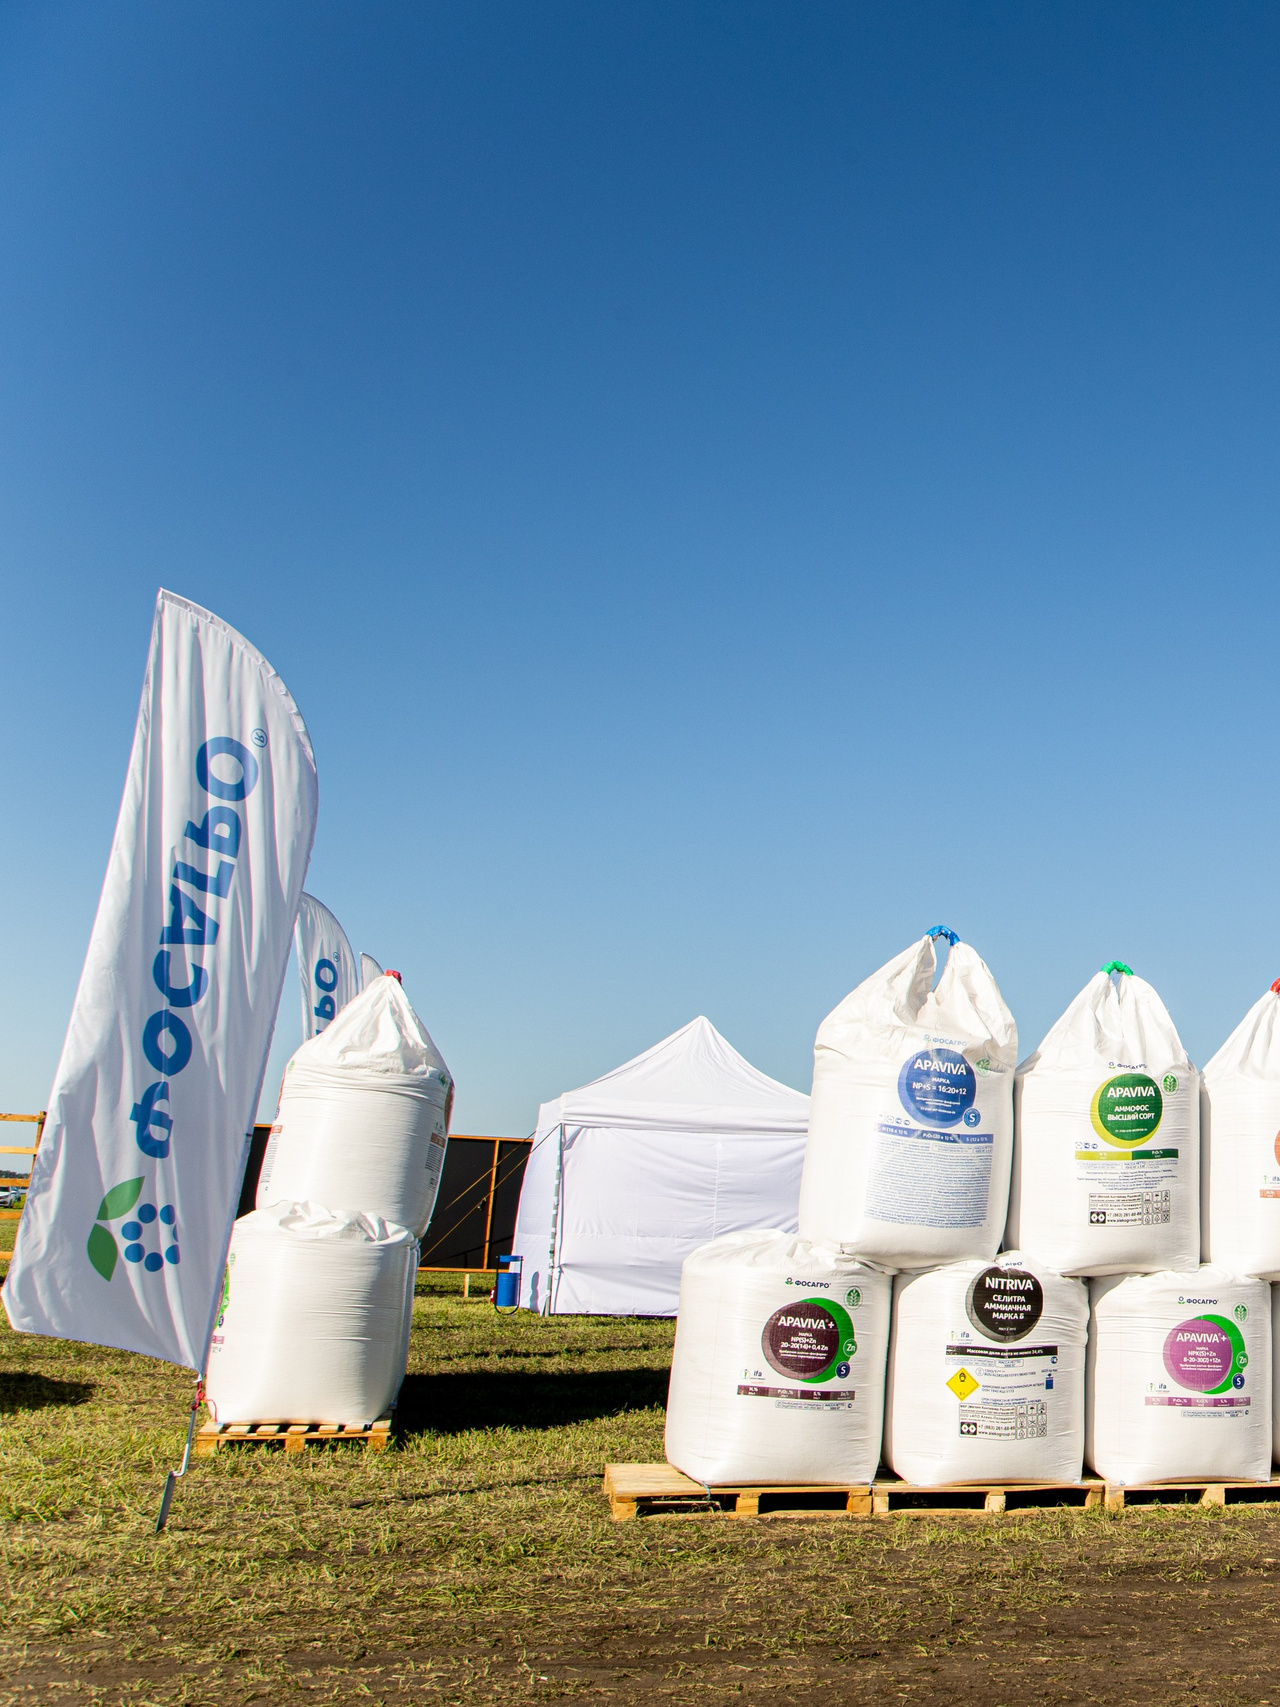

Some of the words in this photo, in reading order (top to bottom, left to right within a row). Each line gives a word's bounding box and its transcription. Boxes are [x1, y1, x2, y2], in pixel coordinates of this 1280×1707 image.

[932, 1037, 967, 1046] ФОСАГРО
[913, 1058, 966, 1075] APAVIVA
[912, 1082, 931, 1091] NP+S
[1107, 1086, 1155, 1098] APAVIVA
[1114, 1104, 1149, 1112] АММОФОС
[969, 1113, 976, 1122] S
[1107, 1113, 1138, 1121] ВЫСШИЙ
[1139, 1112, 1155, 1120] СОРТ
[794, 1280, 830, 1289] ФОСАГРО
[985, 1276, 1033, 1290] NITRIVA
[992, 1294, 1025, 1302] СЕЛИТРА
[984, 1302, 1031, 1311] АММИАЧНАЯ
[846, 1343, 855, 1351] Zn
[840, 1366, 846, 1374] S
[1236, 1377, 1241, 1386] S
